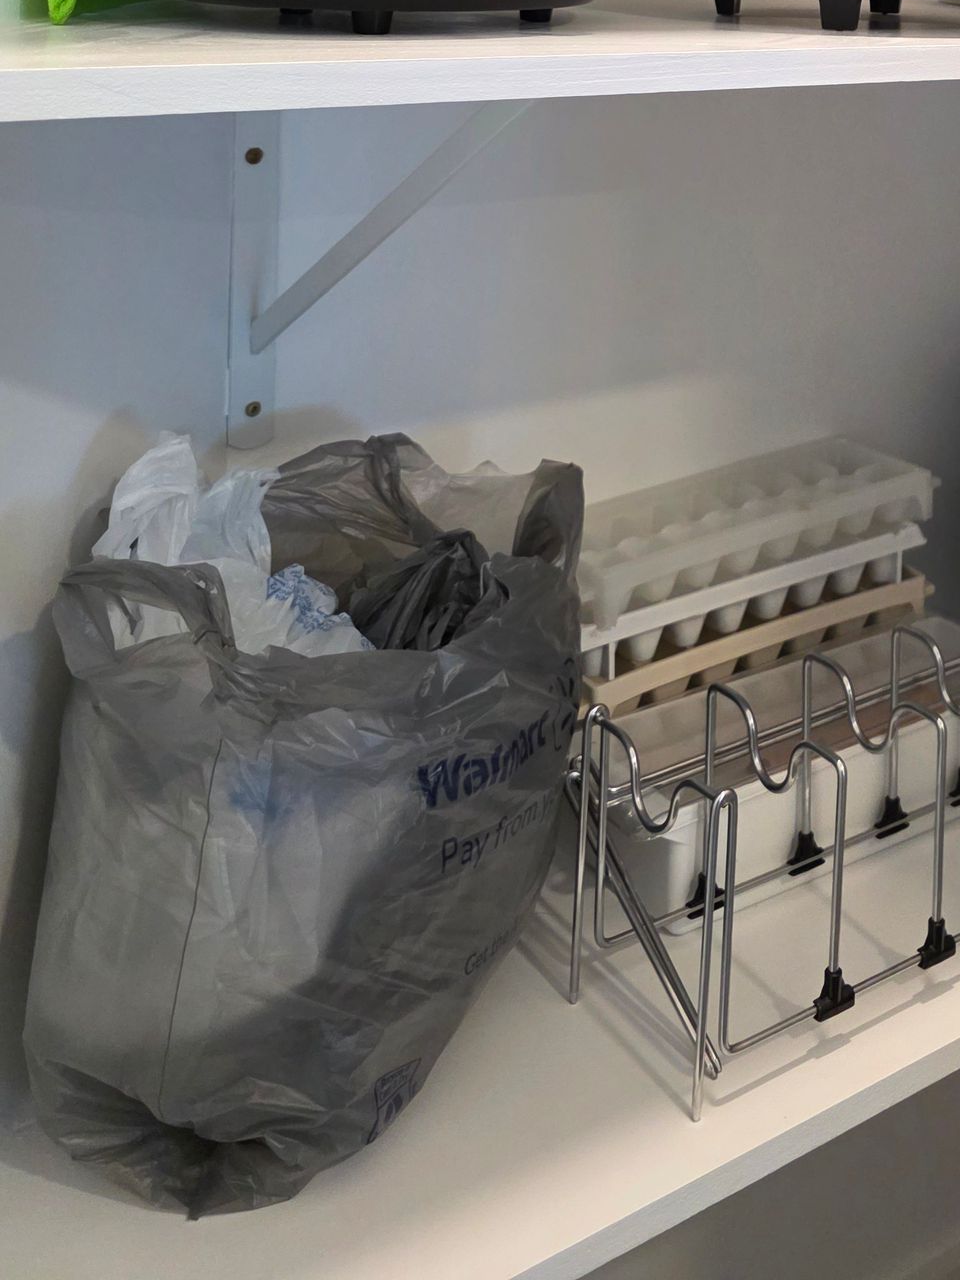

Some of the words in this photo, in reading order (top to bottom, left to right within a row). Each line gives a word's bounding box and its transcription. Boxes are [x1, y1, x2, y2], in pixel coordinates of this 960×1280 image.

[416, 707, 549, 810] Walmart
[440, 831, 491, 875] Pay
[494, 801, 540, 849] from
